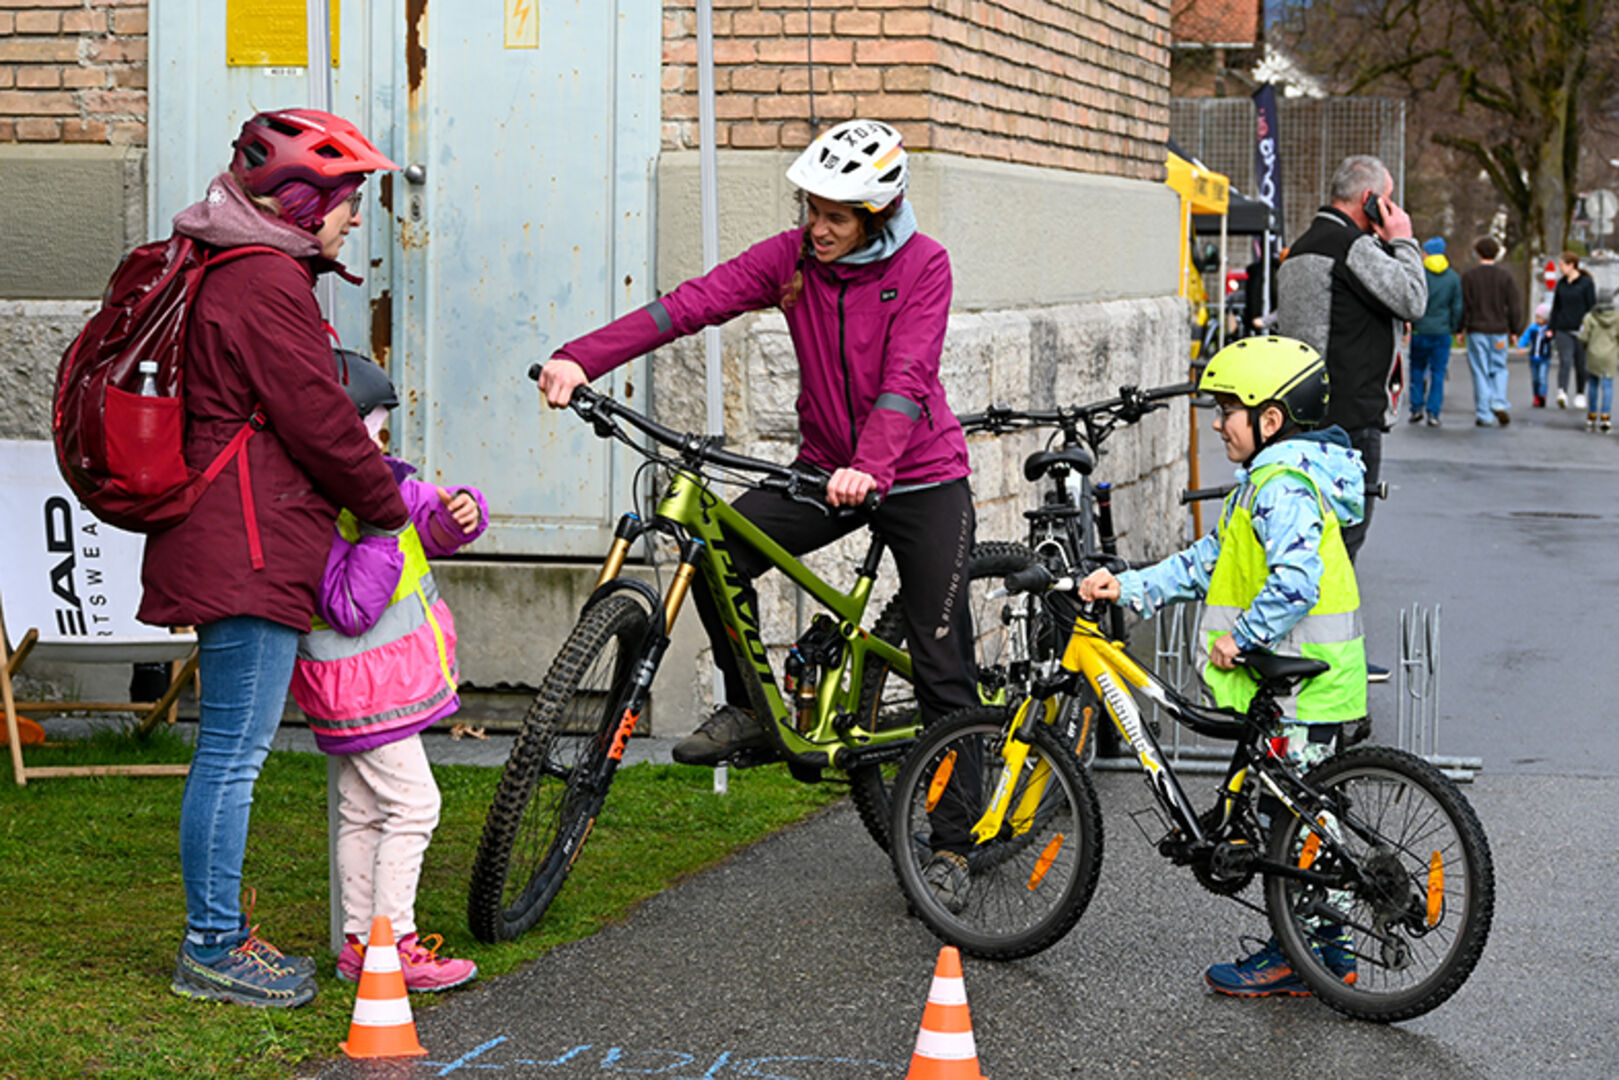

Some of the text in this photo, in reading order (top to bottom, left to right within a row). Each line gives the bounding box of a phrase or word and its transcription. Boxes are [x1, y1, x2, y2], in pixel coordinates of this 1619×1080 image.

[44, 495, 88, 636] EAD
[941, 572, 961, 621] RIDING
[606, 707, 640, 761] FOX
